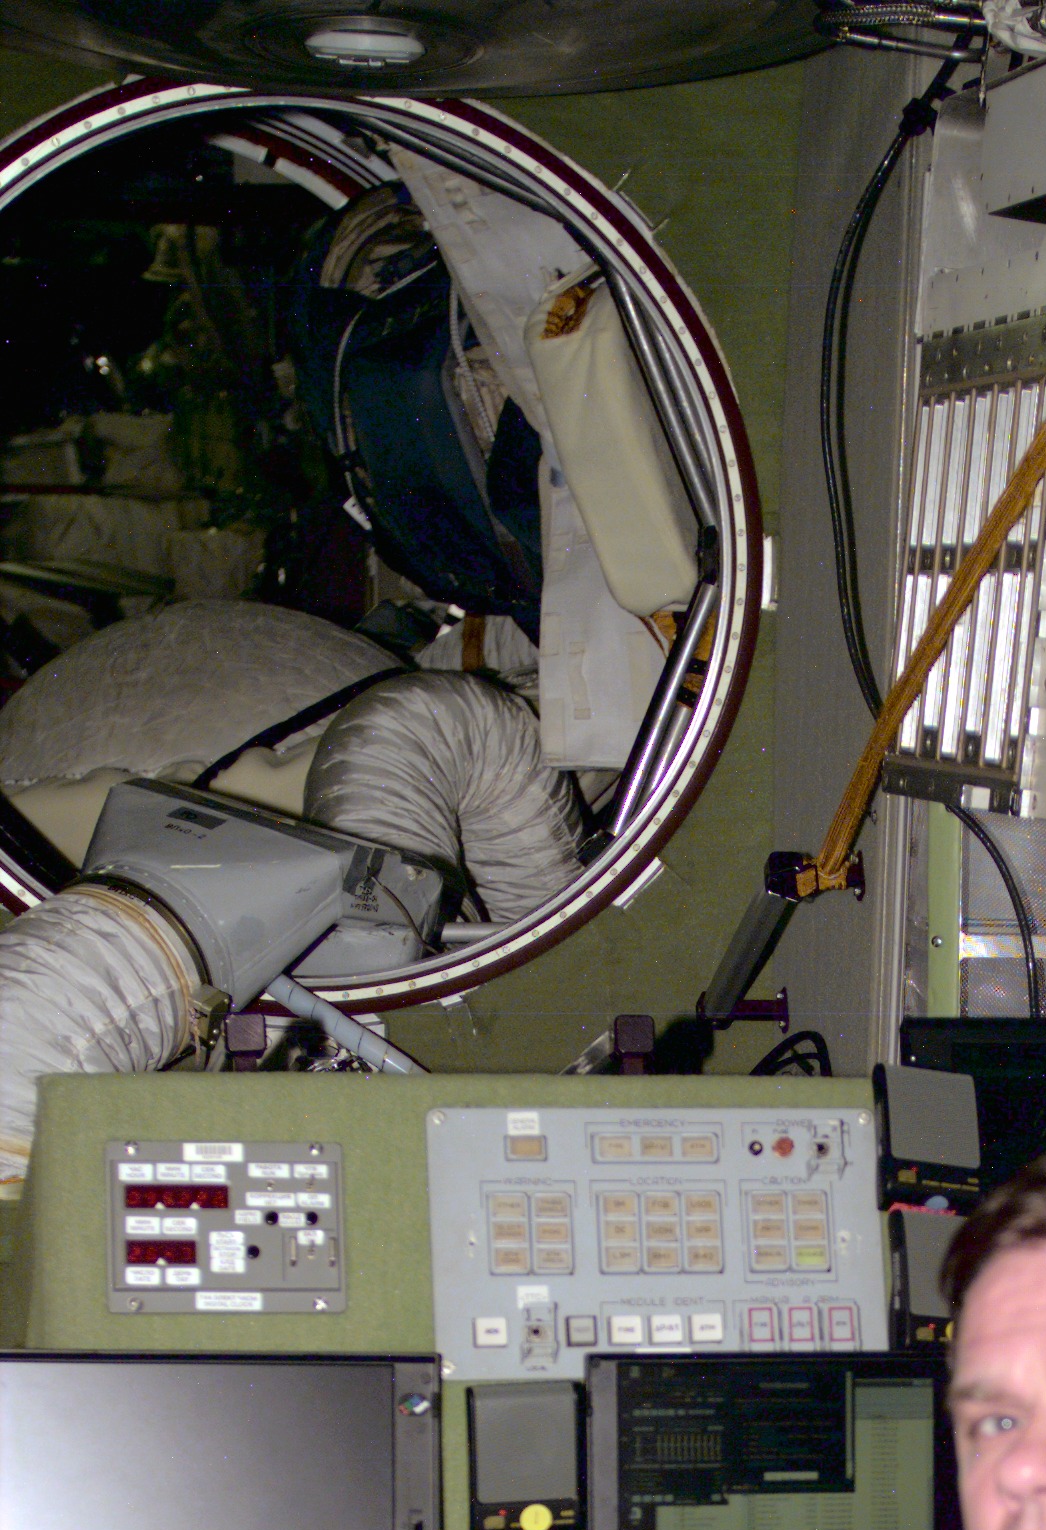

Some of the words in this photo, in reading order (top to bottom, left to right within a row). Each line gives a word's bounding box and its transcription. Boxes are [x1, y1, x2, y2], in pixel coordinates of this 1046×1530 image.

[619, 1118, 685, 1128] EMERGENCY
[503, 1176, 552, 1186] WARNING
[629, 1176, 682, 1186] LOCATION
[760, 1176, 807, 1186] CAUTION
[764, 1276, 816, 1287] ADVISORY
[620, 1296, 666, 1306] MODULE
[673, 1296, 704, 1306] IDENT
